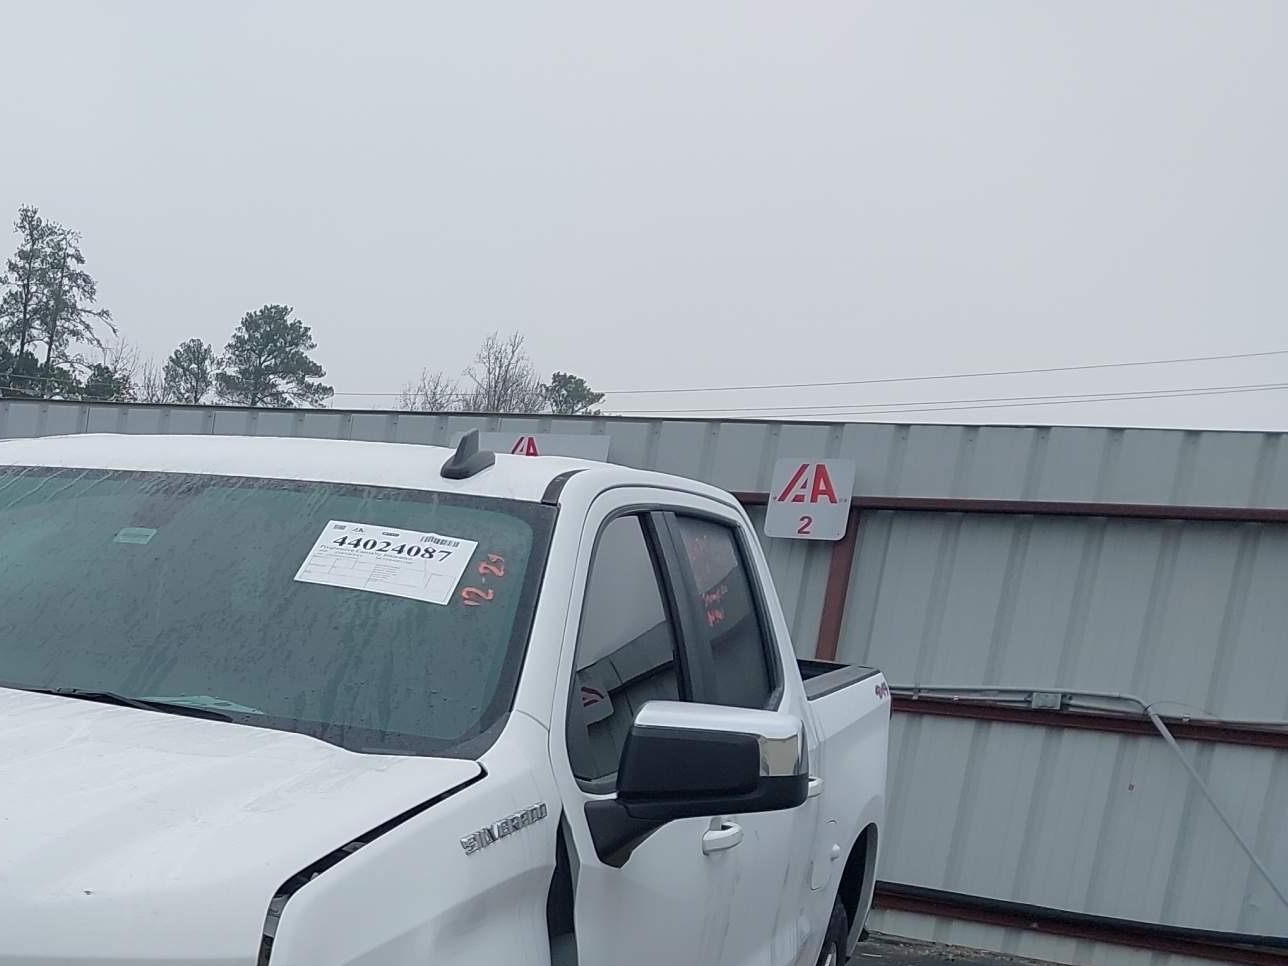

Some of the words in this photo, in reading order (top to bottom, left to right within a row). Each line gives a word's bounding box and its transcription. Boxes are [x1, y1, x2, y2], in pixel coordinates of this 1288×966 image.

[797, 515, 813, 535] 2
[332, 534, 452, 562] 44024087
[459, 801, 548, 856] SILVERADO
